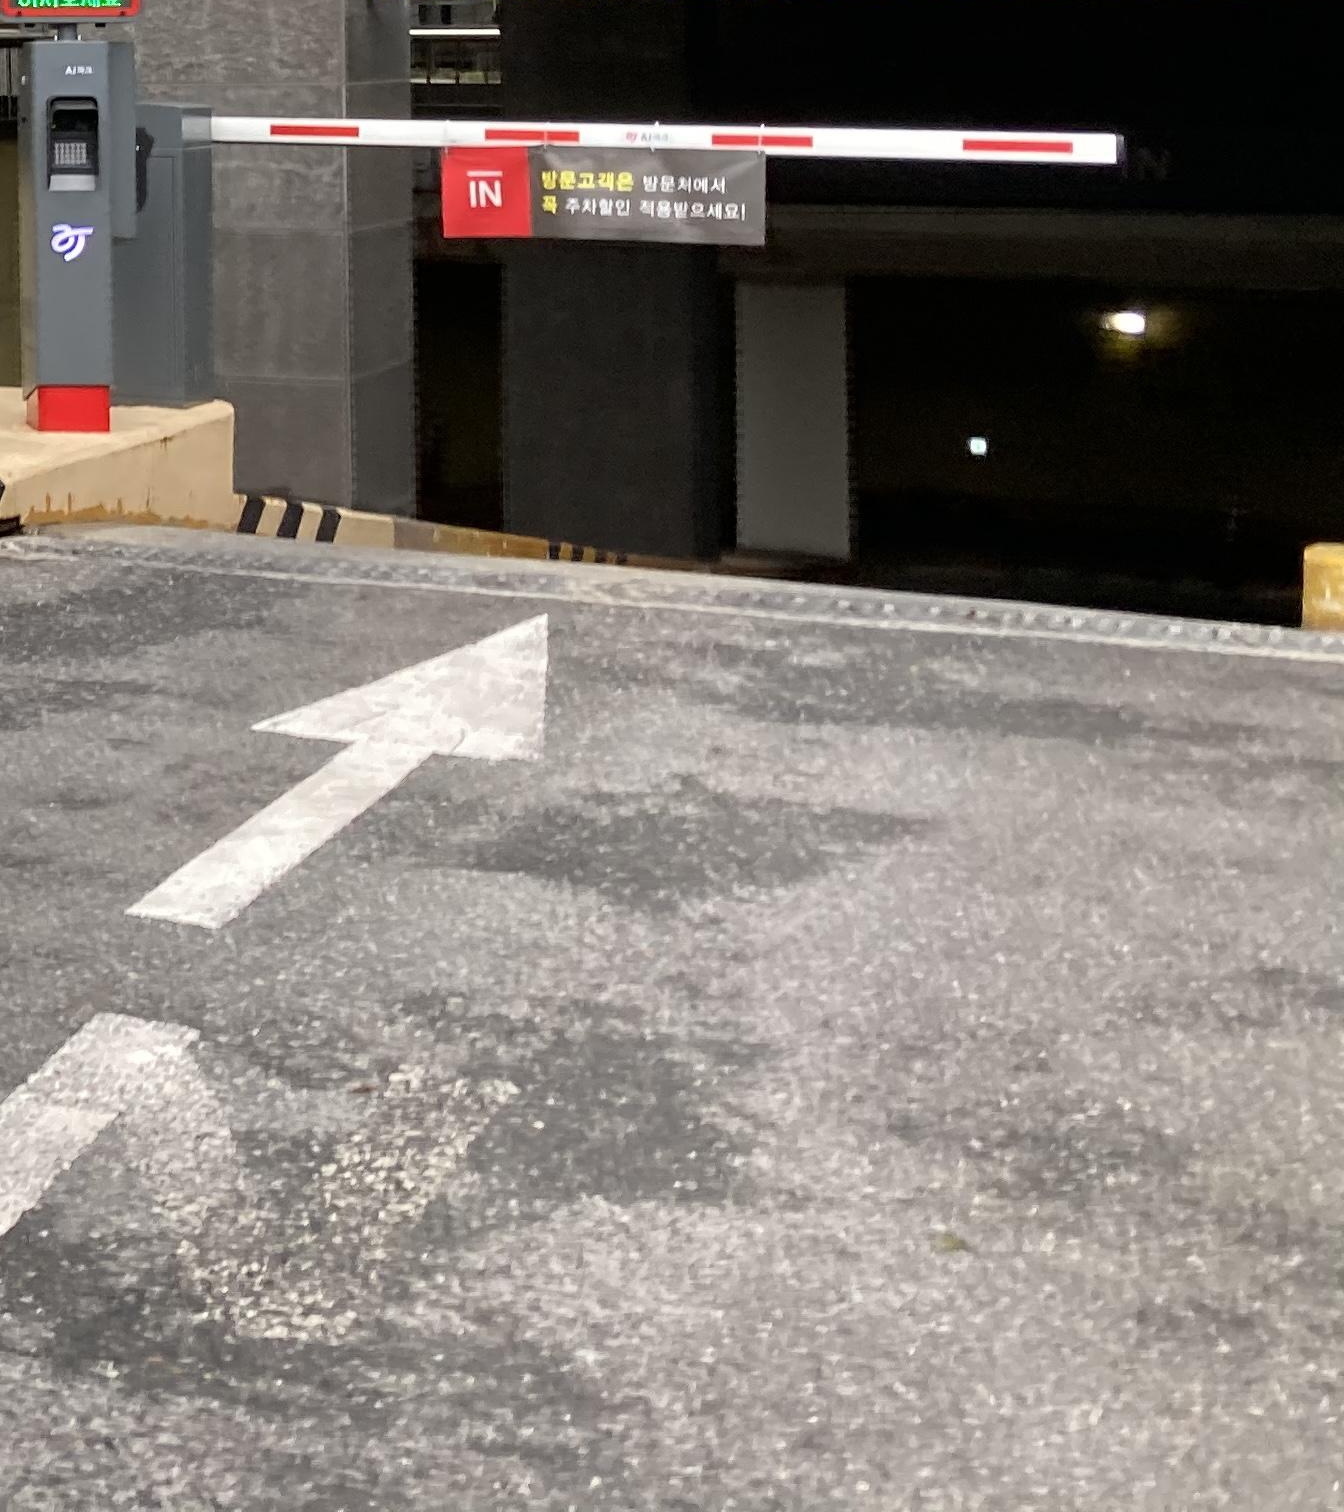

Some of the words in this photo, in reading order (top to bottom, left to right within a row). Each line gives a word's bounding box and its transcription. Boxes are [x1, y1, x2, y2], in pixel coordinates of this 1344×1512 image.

[541, 170, 634, 192] 방문고객은
[469, 180, 503, 208] IN
[565, 197, 630, 216] 주차할인
